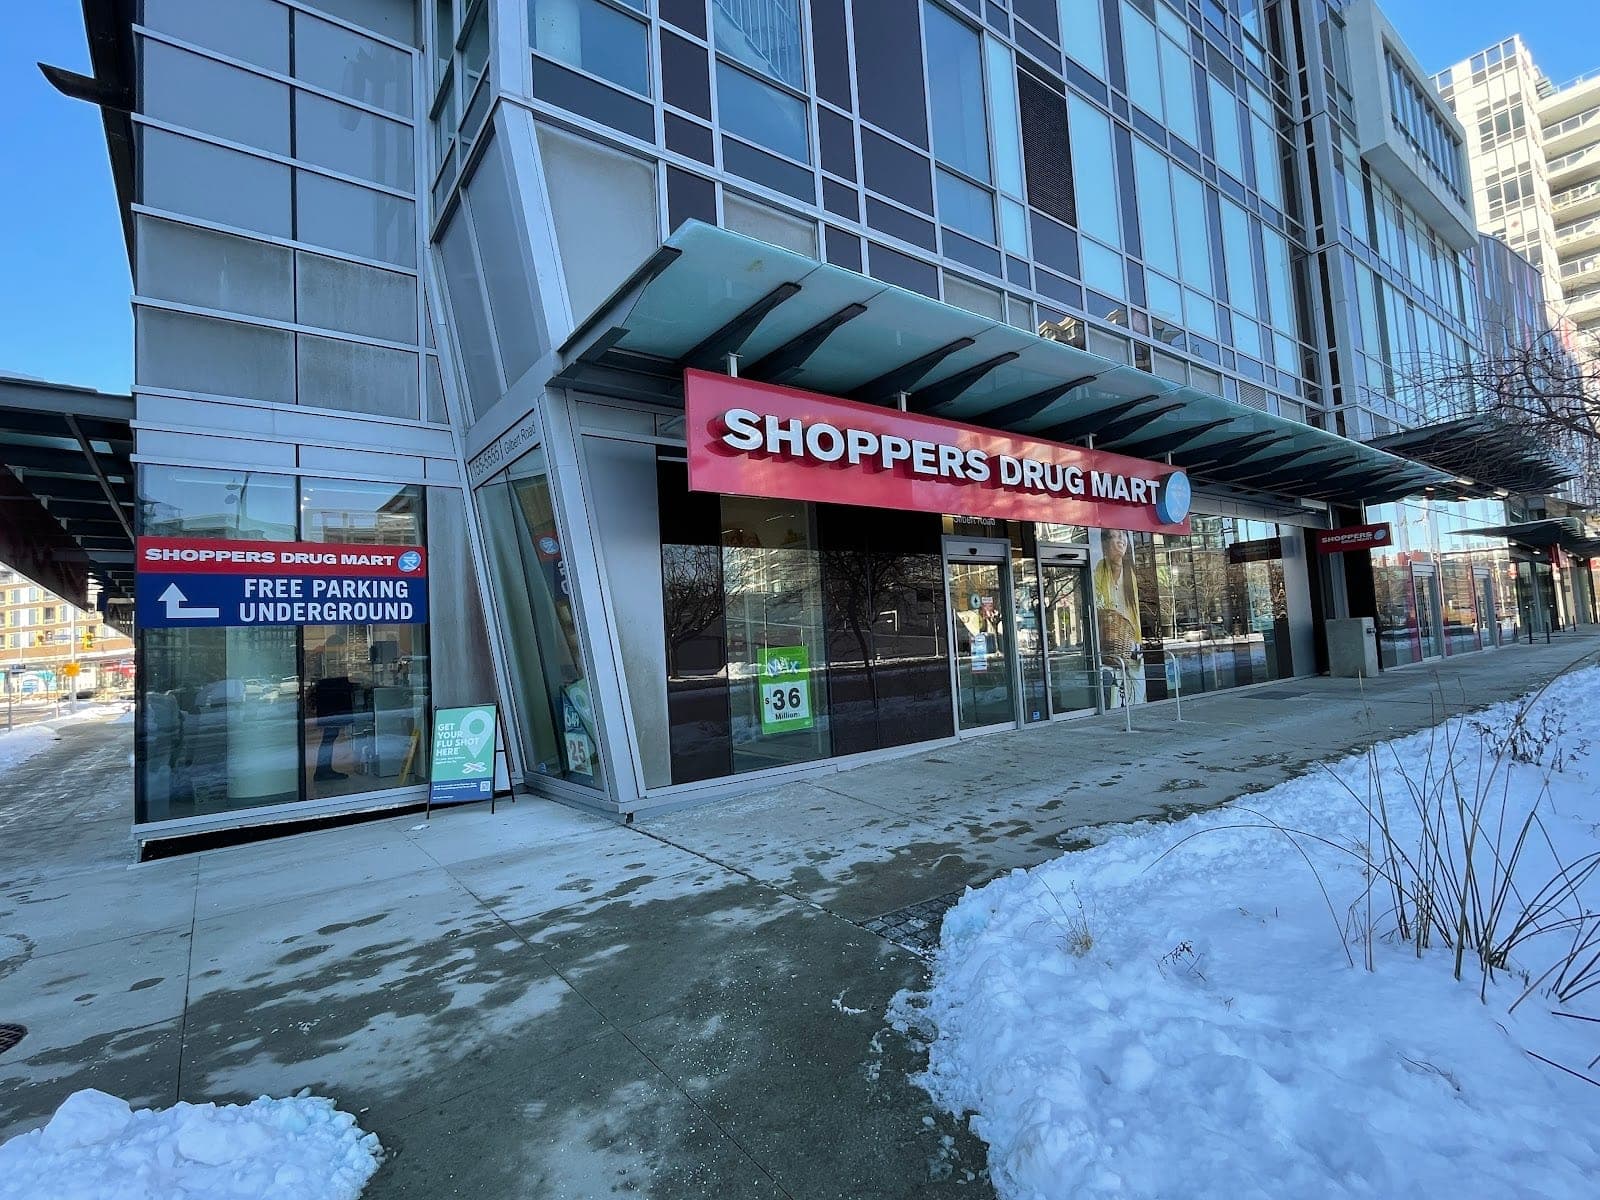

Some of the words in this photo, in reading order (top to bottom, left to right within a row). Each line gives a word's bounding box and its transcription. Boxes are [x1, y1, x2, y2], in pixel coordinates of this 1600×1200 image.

[521, 421, 536, 441] Road
[722, 408, 992, 482] SHOPPERS
[1000, 454, 1085, 495] DRUG
[1091, 470, 1161, 505] MART
[1321, 532, 1373, 543] SHOPPERS
[145, 548, 275, 563] SHOPPERS
[280, 551, 337, 565] DRUG
[341, 554, 395, 566] MART
[244, 578, 303, 599] FREE
[312, 579, 409, 599] PARKING
[239, 602, 413, 622] UNDERGROUND
[437, 723, 456, 731] GET
[438, 731, 464, 740] YOUR
[436, 740, 453, 748] FLU
[454, 737, 481, 747] SHOT
